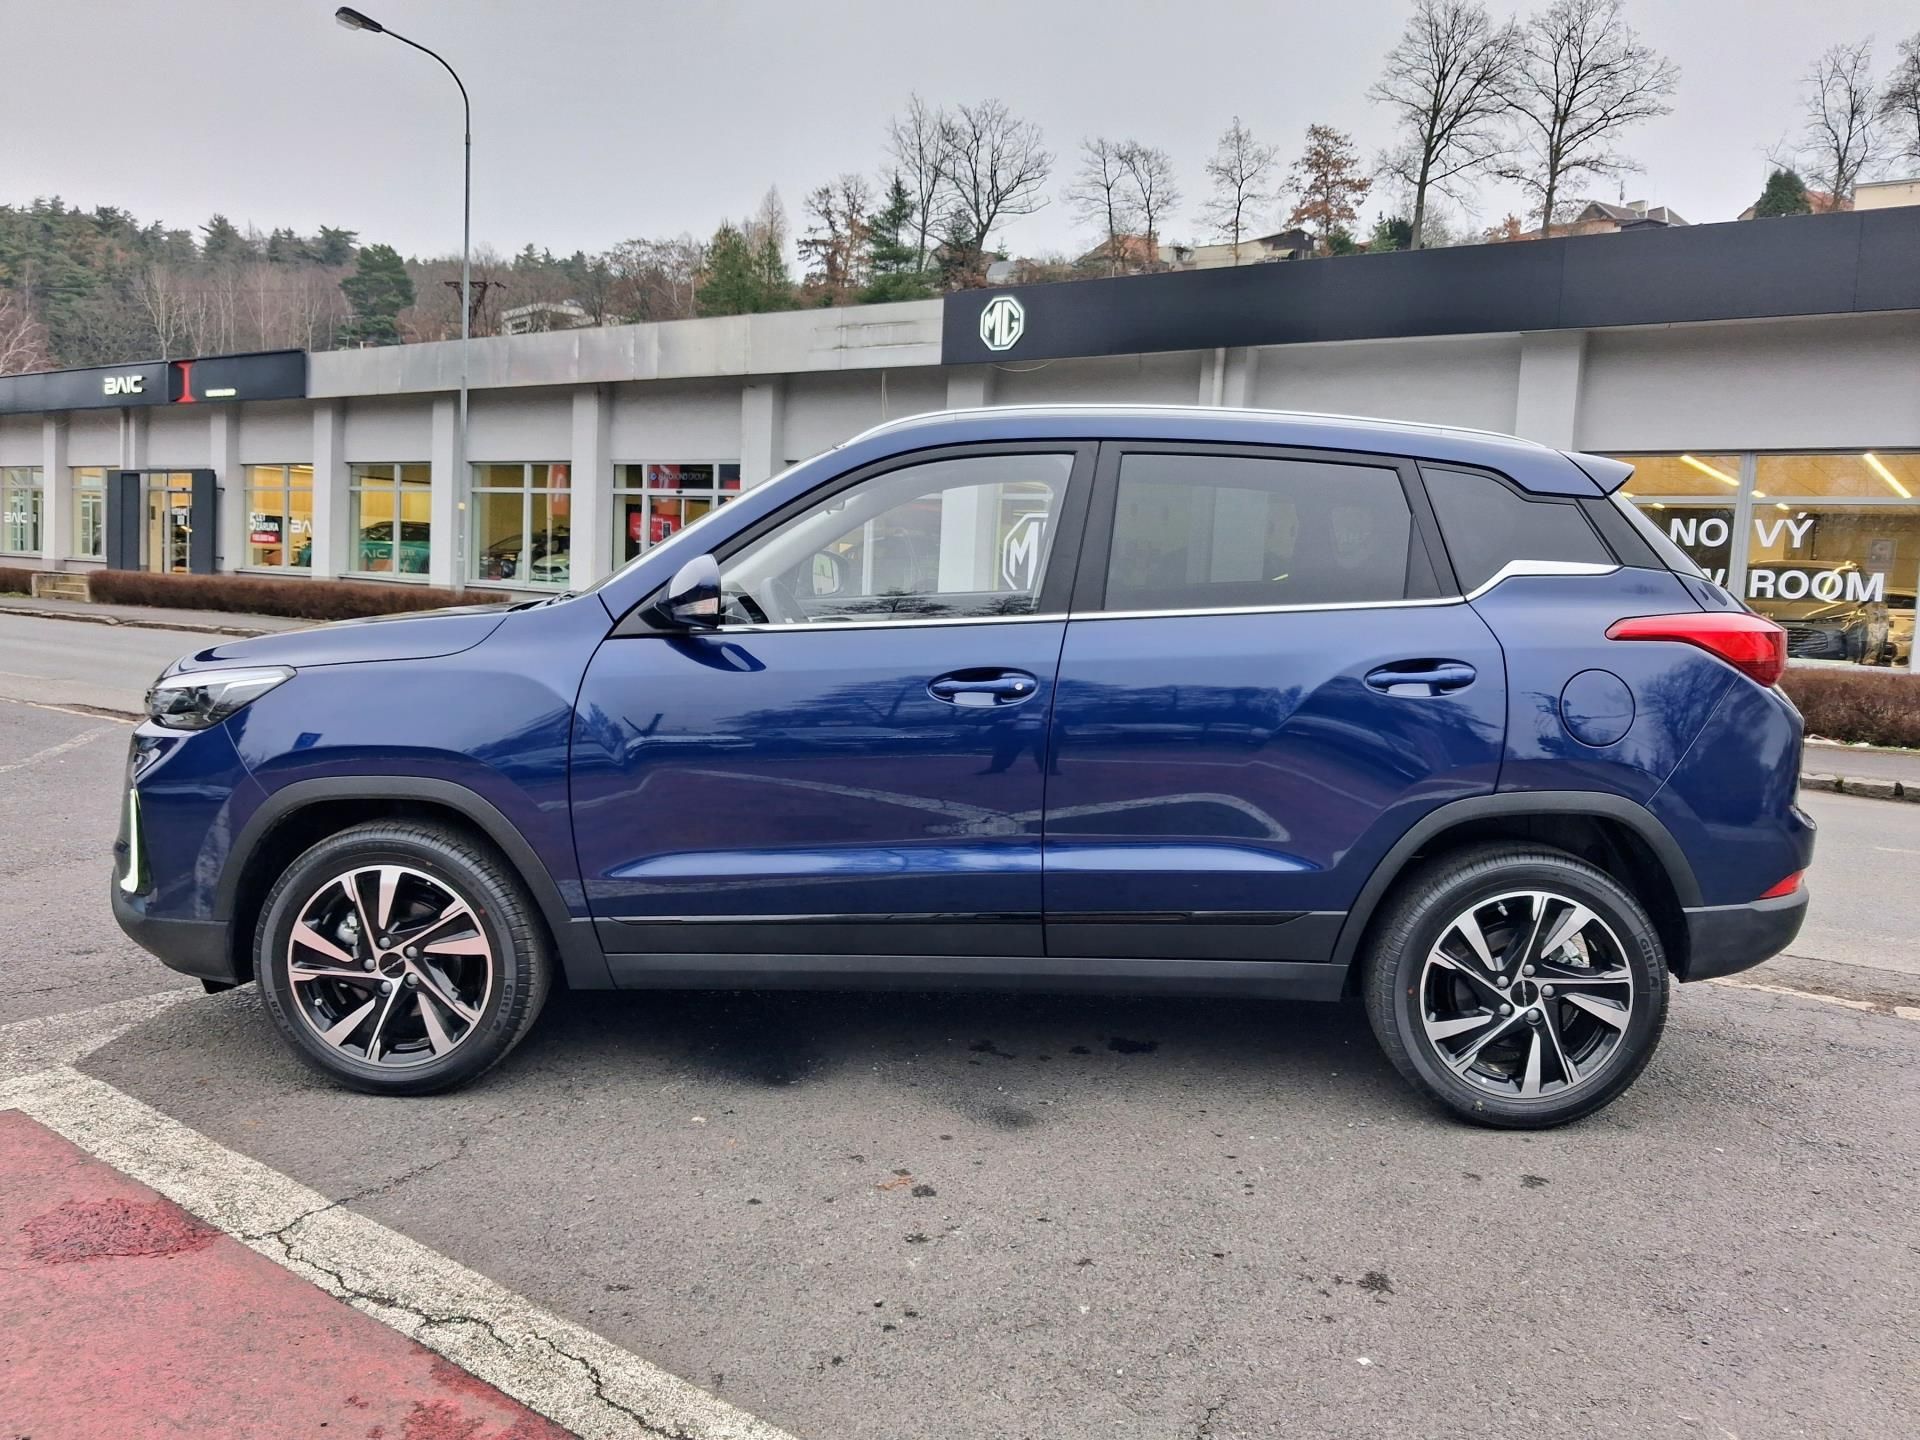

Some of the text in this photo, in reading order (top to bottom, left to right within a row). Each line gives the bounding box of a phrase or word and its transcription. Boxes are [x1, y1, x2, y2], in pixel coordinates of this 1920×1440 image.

[984, 300, 1021, 346] MG
[103, 375, 143, 395] BAIC
[1749, 568, 1885, 603] ROOM
